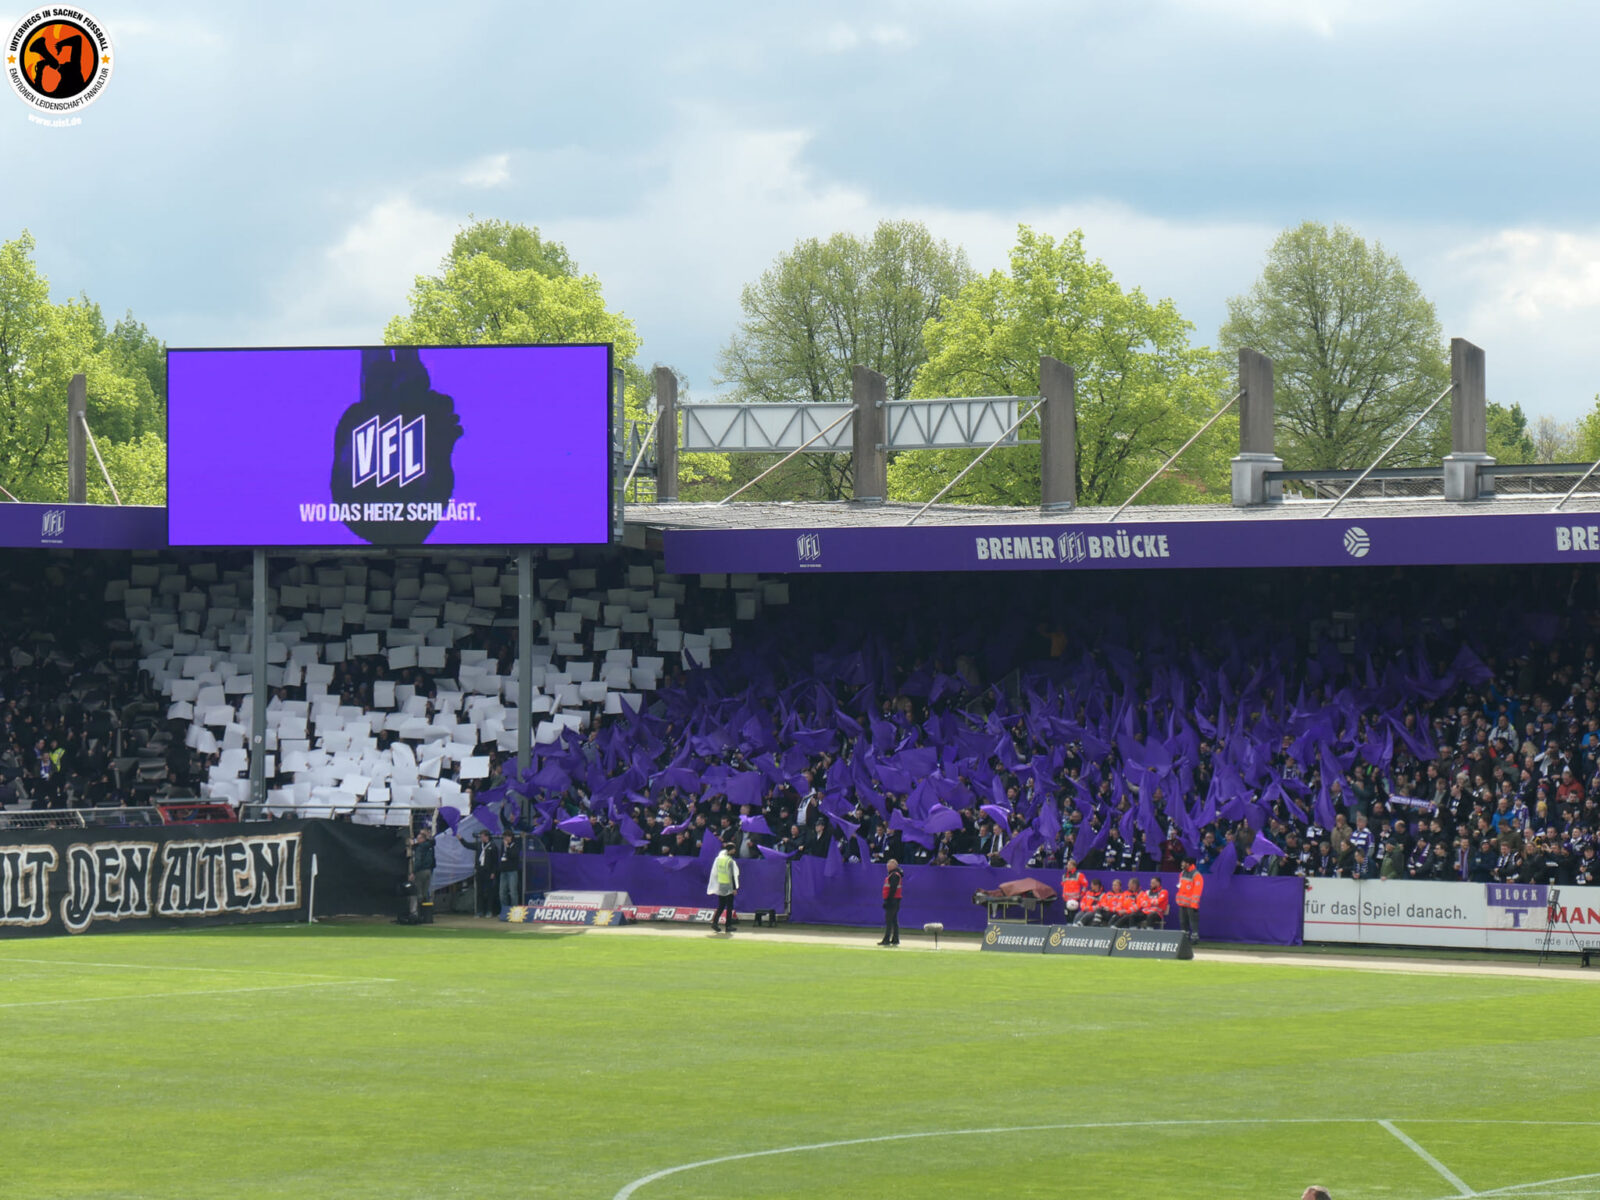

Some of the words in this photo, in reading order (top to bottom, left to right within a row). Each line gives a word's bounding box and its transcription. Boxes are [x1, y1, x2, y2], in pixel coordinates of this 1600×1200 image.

[354, 417, 424, 487] VFL
[300, 503, 326, 522] WO
[329, 503, 361, 522] DAS
[364, 503, 404, 521] HERZ
[406, 498, 481, 522] SCHLÄGT.
[42, 510, 65, 536] VFL
[797, 534, 820, 560] VFL
[976, 536, 1056, 560] BREMER
[1088, 530, 1170, 558] BRÜCKE
[61, 842, 157, 934] DEN
[154, 832, 302, 918] ALTEN!
[1495, 888, 1538, 900] BLOCK
[534, 908, 588, 922] MERKUR
[1305, 900, 1326, 914] für
[1330, 902, 1357, 916] das
[1363, 902, 1400, 919] Spiel
[1406, 904, 1467, 920] danach.
[1505, 908, 1528, 928] T
[1028, 937, 1045, 946] WELZ
[1094, 940, 1110, 948] WELZ
[1161, 942, 1178, 952] WELZ
